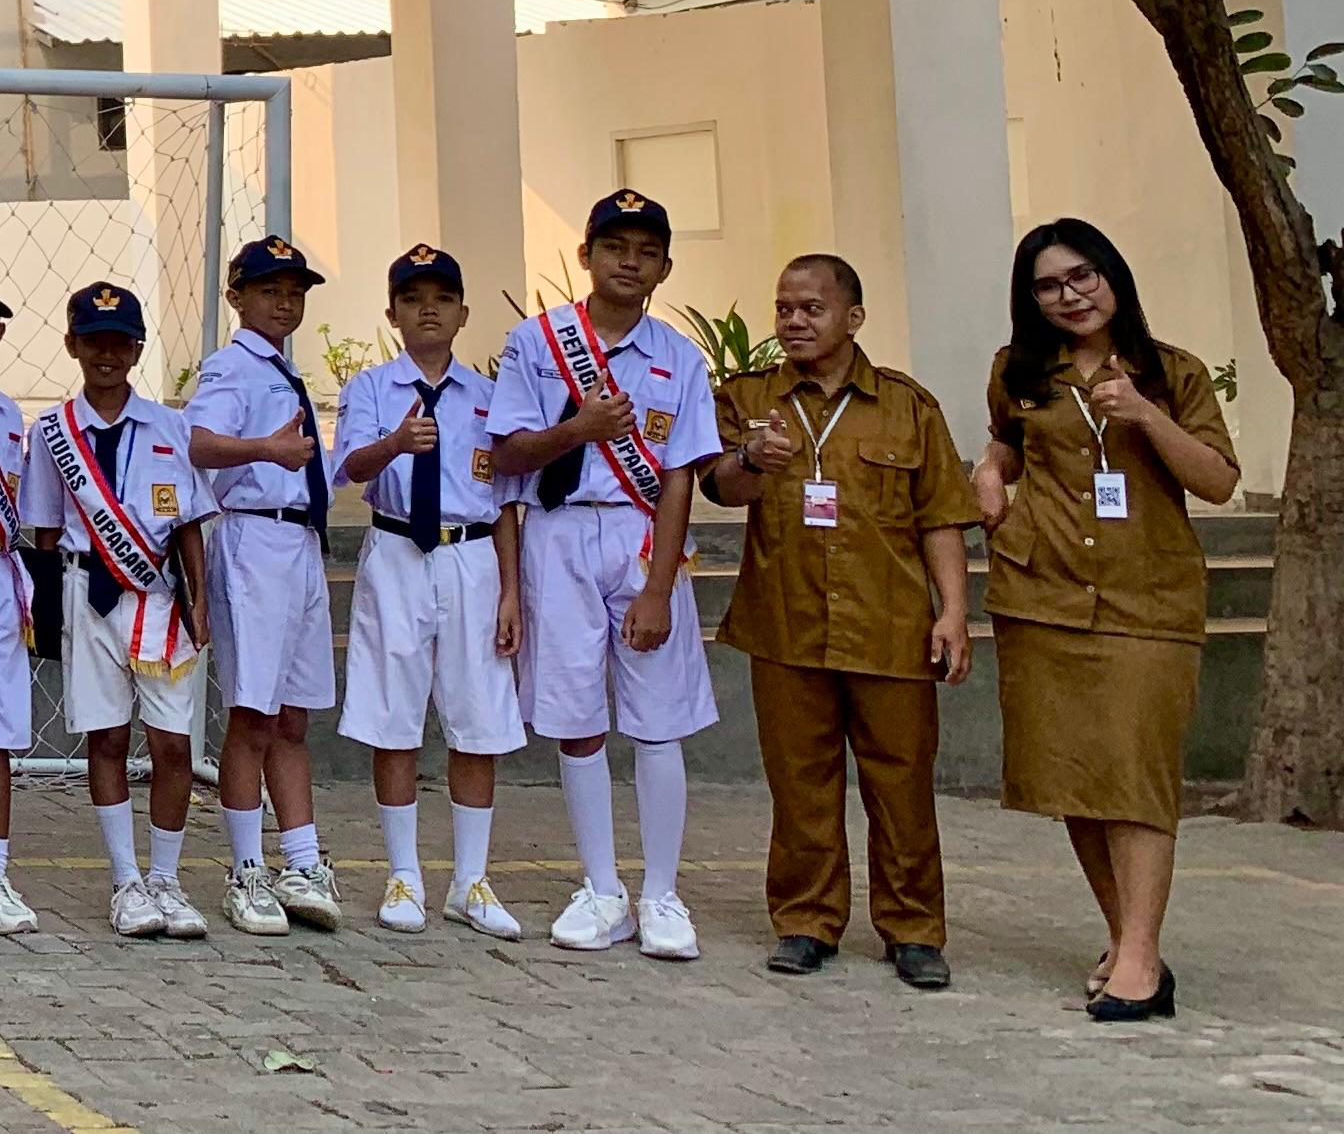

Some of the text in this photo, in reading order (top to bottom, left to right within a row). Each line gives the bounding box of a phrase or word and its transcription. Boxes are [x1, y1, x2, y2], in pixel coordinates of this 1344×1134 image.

[557, 324, 610, 400] PETUG
[40, 413, 157, 588] PETUGAS UPACARA
